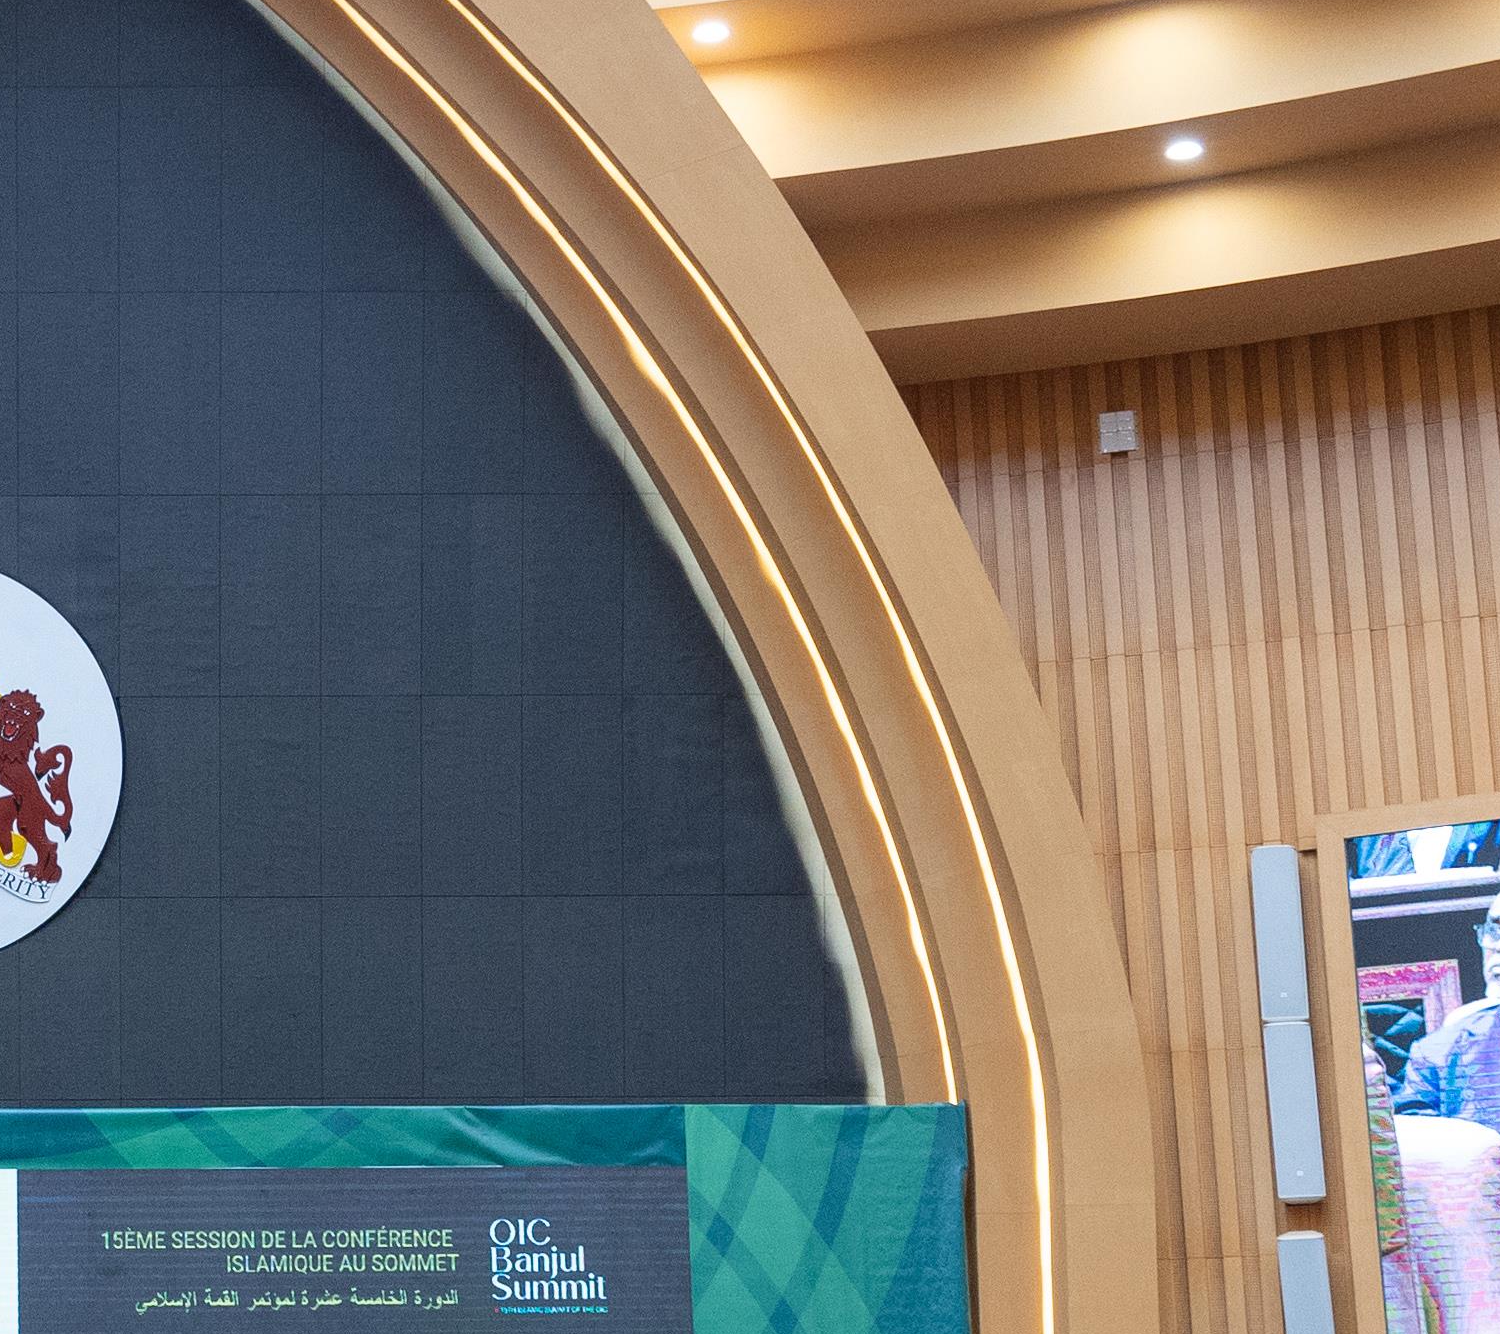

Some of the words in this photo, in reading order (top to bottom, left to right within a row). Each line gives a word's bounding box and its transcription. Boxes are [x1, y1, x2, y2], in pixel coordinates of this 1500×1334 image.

[101, 1227, 166, 1249] 15ÈME
[171, 1230, 256, 1249] SESSION
[261, 1230, 286, 1249] DE
[292, 1230, 317, 1248] LA
[322, 1226, 453, 1248] CONFÉRENCE
[489, 1218, 551, 1246] OIC
[226, 1254, 334, 1274] ISLAMIQUE
[339, 1254, 366, 1272] AU
[371, 1253, 459, 1272] SOMMET
[490, 1245, 585, 1279] Banjul
[350, 1287, 408, 1306] الخامسة
[491, 1272, 607, 1300] Summit
[135, 1291, 197, 1315] الإسلامي
[204, 1288, 239, 1307] القمة
[300, 1289, 343, 1311] عشرة
[413, 1289, 459, 1310] الدورة
